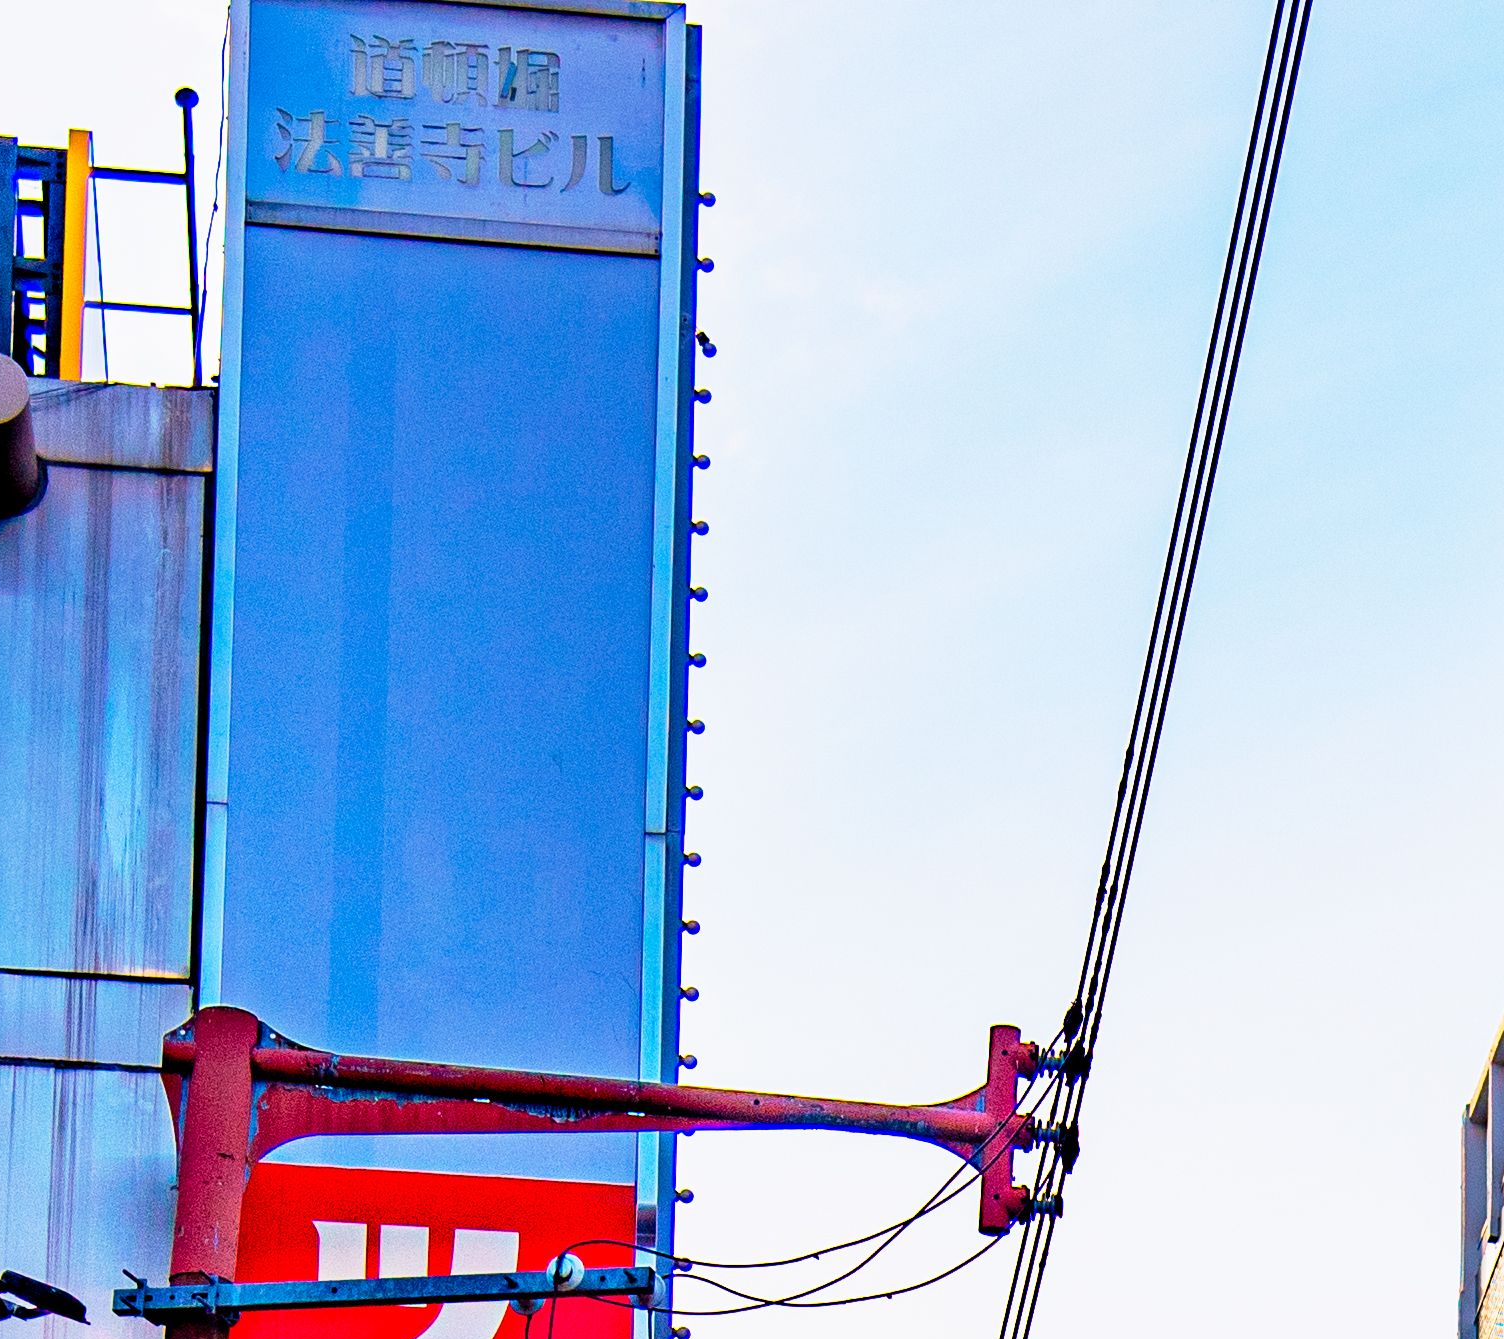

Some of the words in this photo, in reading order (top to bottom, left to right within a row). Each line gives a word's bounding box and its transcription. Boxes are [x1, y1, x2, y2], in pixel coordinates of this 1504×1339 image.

[349, 33, 561, 113] 道頓堀
[274, 108, 630, 196] 法善寺ビル
